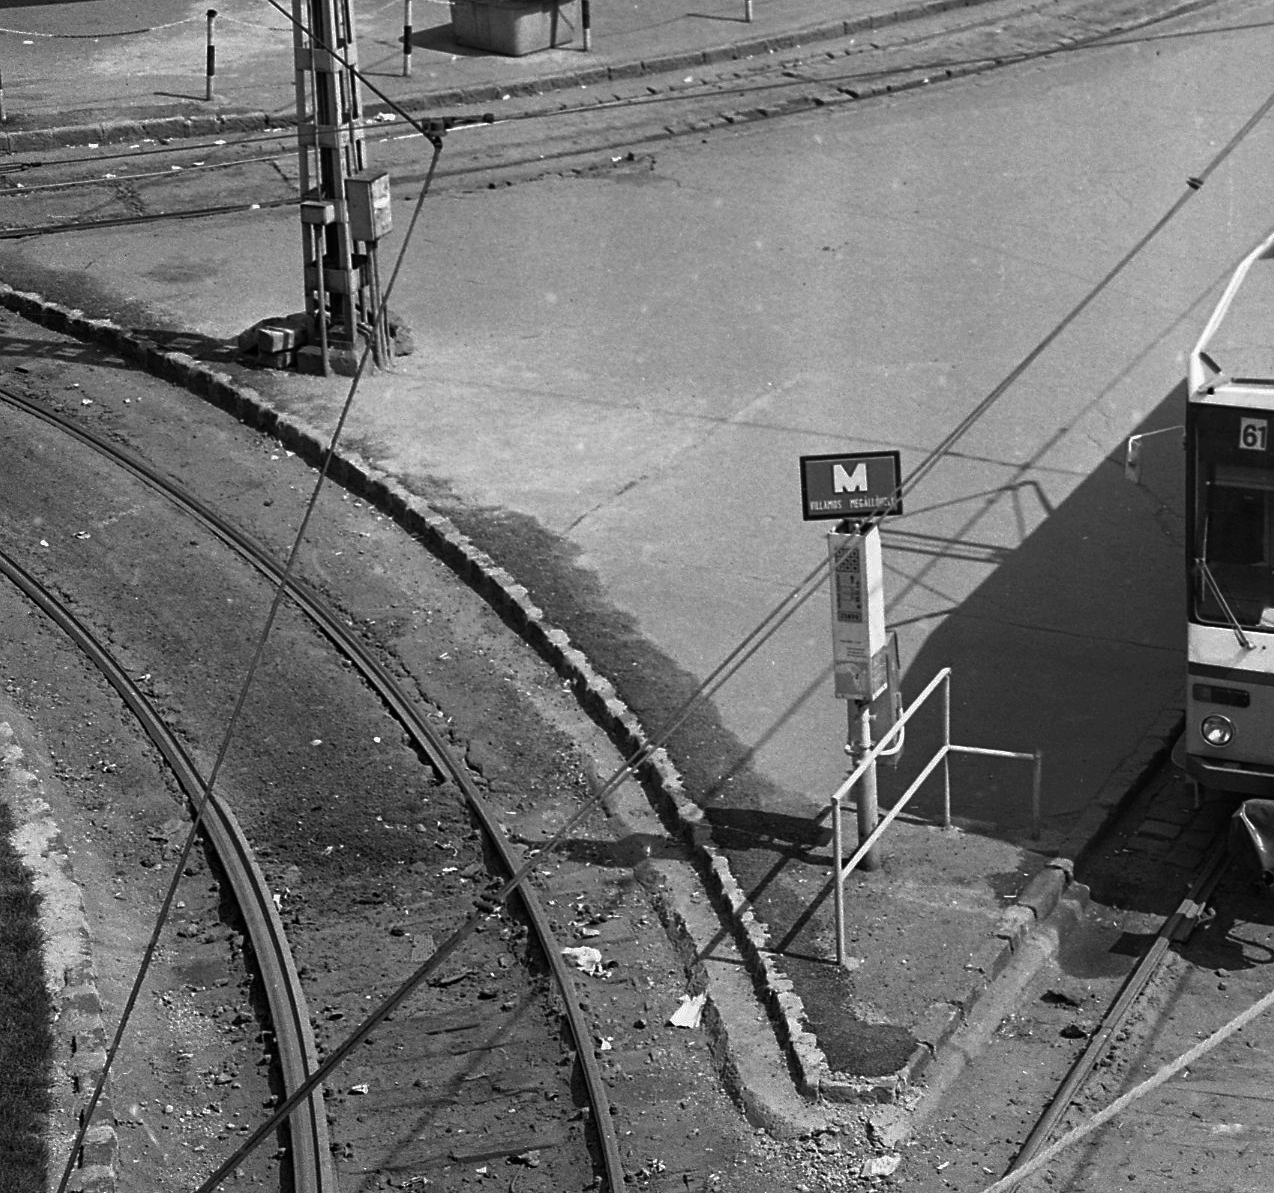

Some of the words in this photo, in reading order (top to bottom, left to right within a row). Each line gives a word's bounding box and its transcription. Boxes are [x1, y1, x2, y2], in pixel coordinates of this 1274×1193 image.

[1242, 424, 1267, 448] 61
[833, 463, 868, 494] M
[810, 499, 842, 511] VILLAMOS
